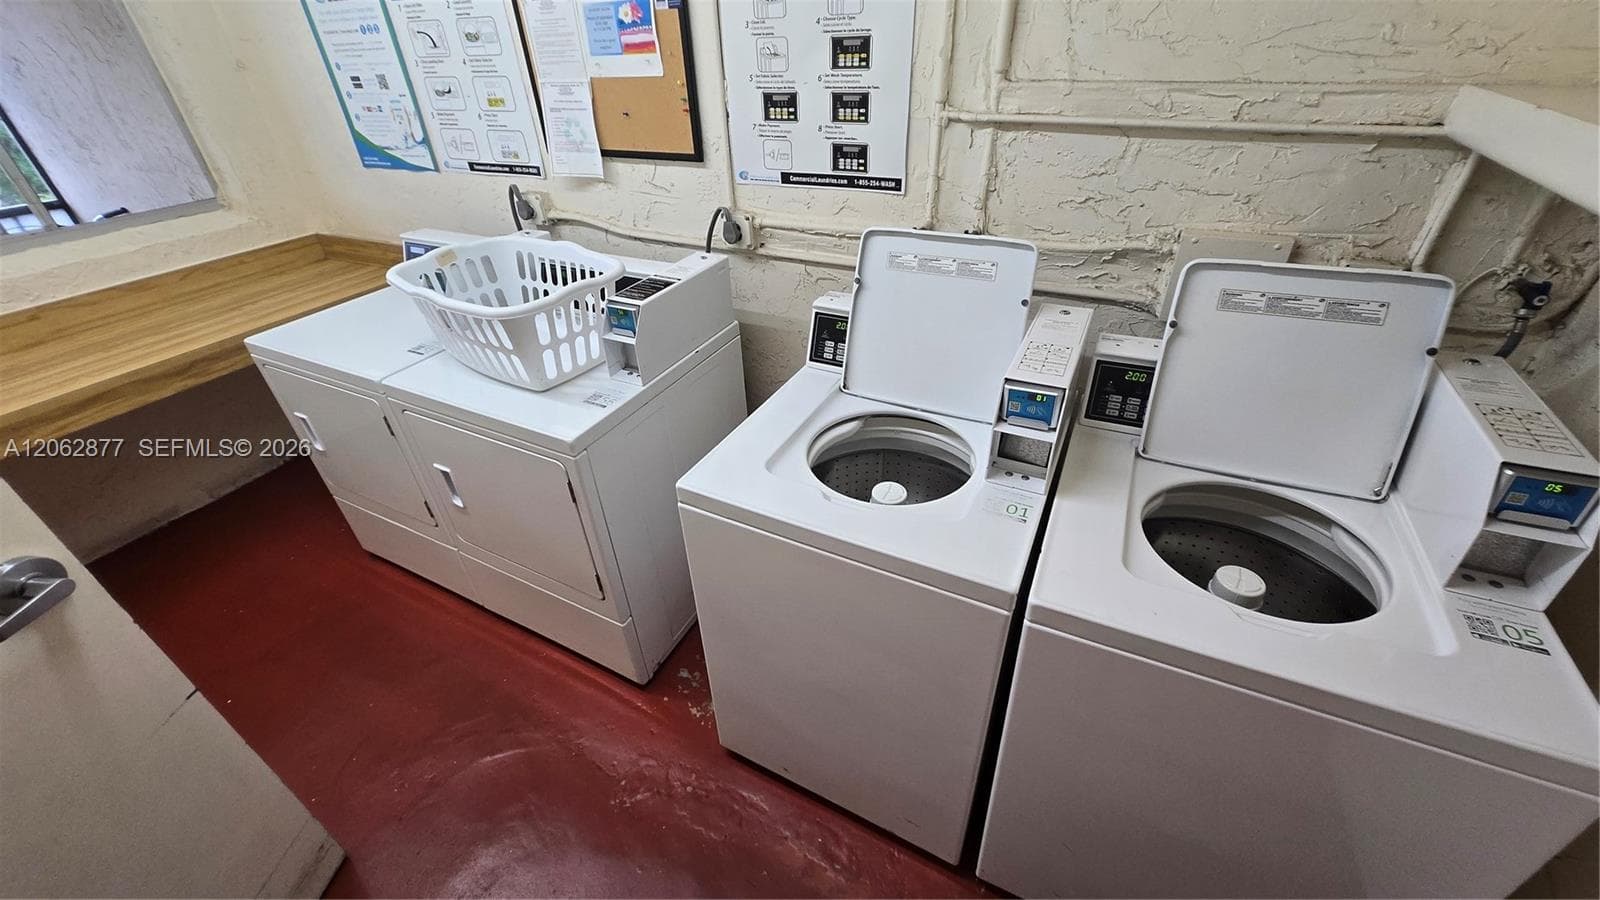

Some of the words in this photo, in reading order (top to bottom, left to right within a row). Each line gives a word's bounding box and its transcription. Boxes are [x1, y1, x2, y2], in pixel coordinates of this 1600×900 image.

[815, 16, 821, 25] 4
[748, 74, 754, 82] 5
[817, 74, 822, 82] 6
[789, 175, 848, 185] CommercialLaundries.com
[854, 179, 896, 188] 1-855-254-WASH
[1036, 394, 1047, 402] 01
[1544, 483, 1564, 493] 05
[1006, 504, 1029, 518] 01
[1502, 624, 1544, 645] 05
